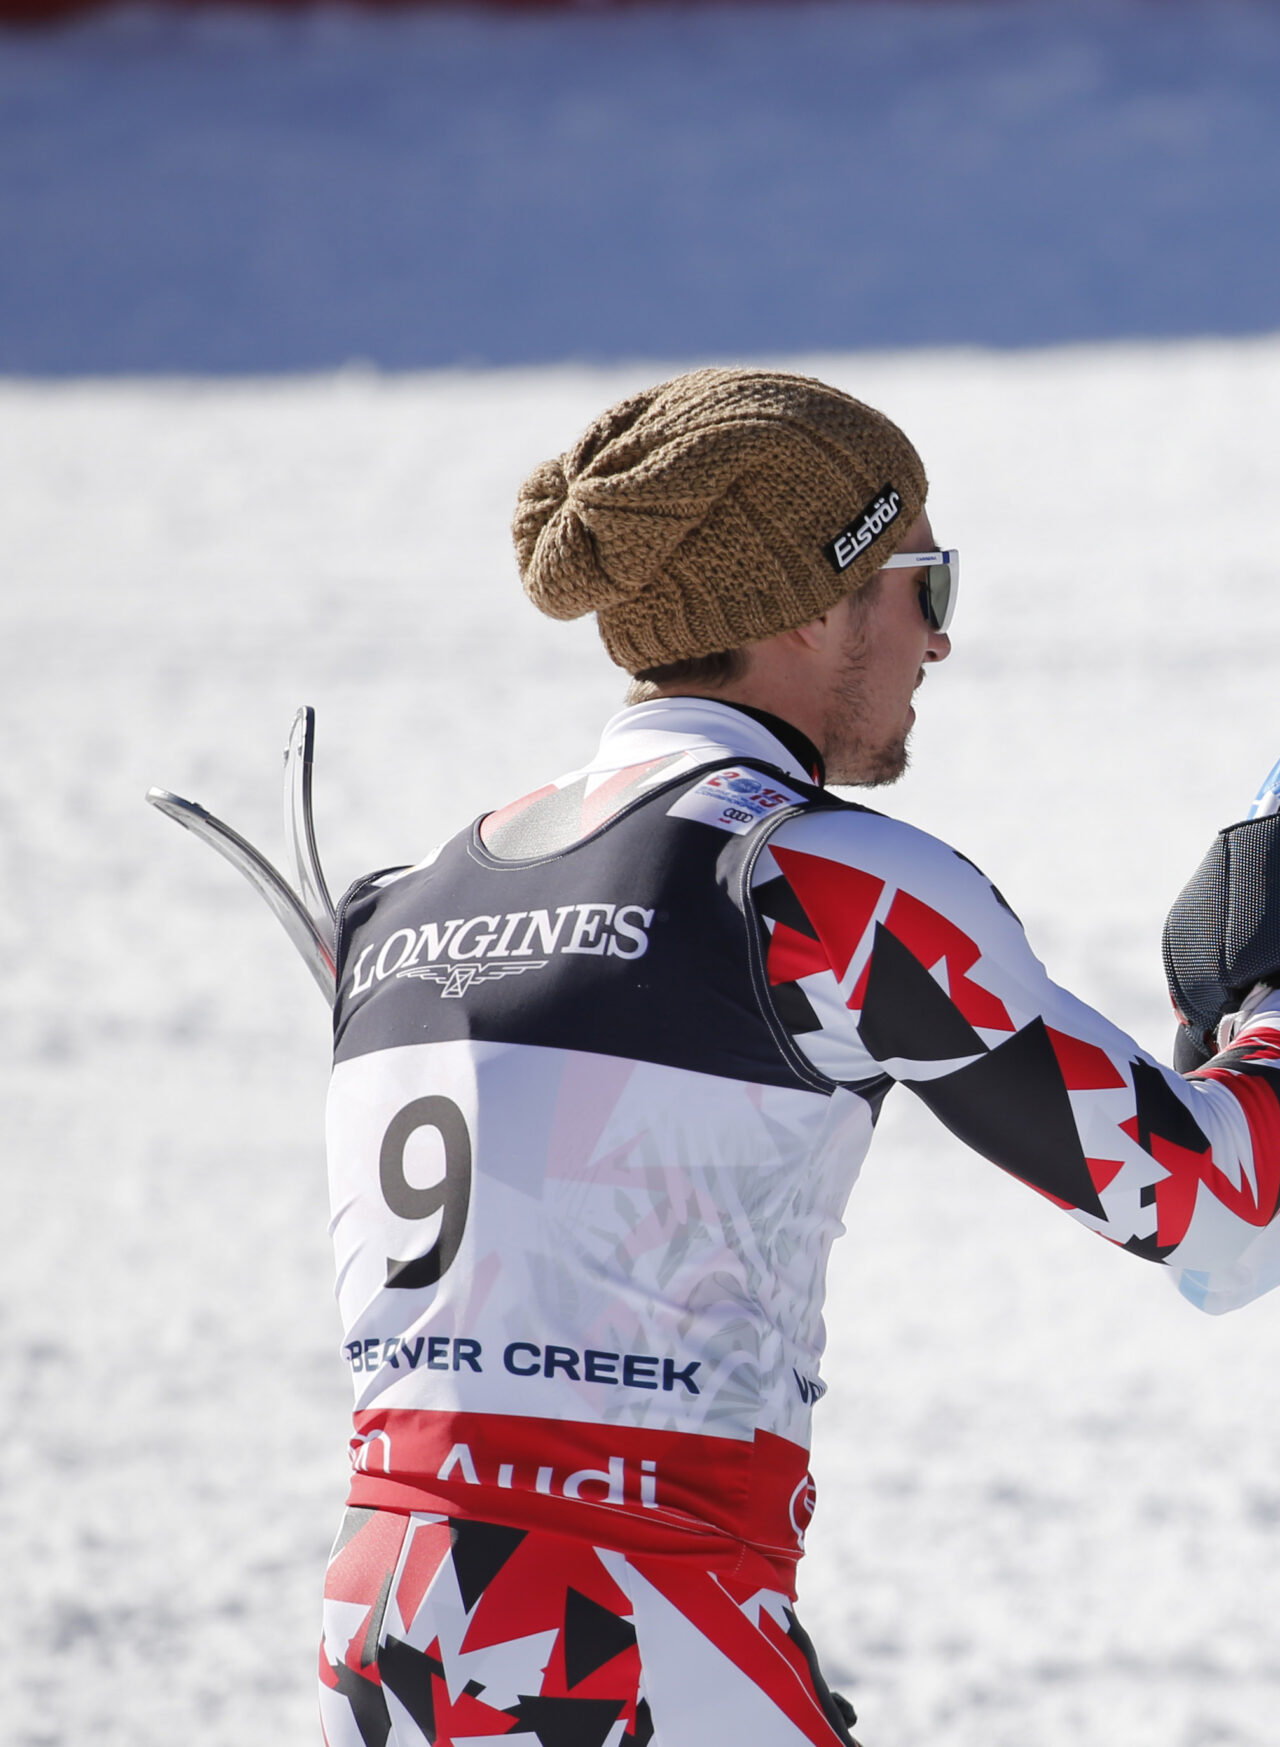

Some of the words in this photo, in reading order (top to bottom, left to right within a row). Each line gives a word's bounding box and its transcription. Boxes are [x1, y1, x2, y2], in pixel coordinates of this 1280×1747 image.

[833, 491, 900, 568] Eisbär
[348, 903, 655, 1000] LONGINES
[378, 1094, 473, 1290] 9
[345, 1336, 483, 1374] BEAVER
[502, 1341, 702, 1395] CREEK
